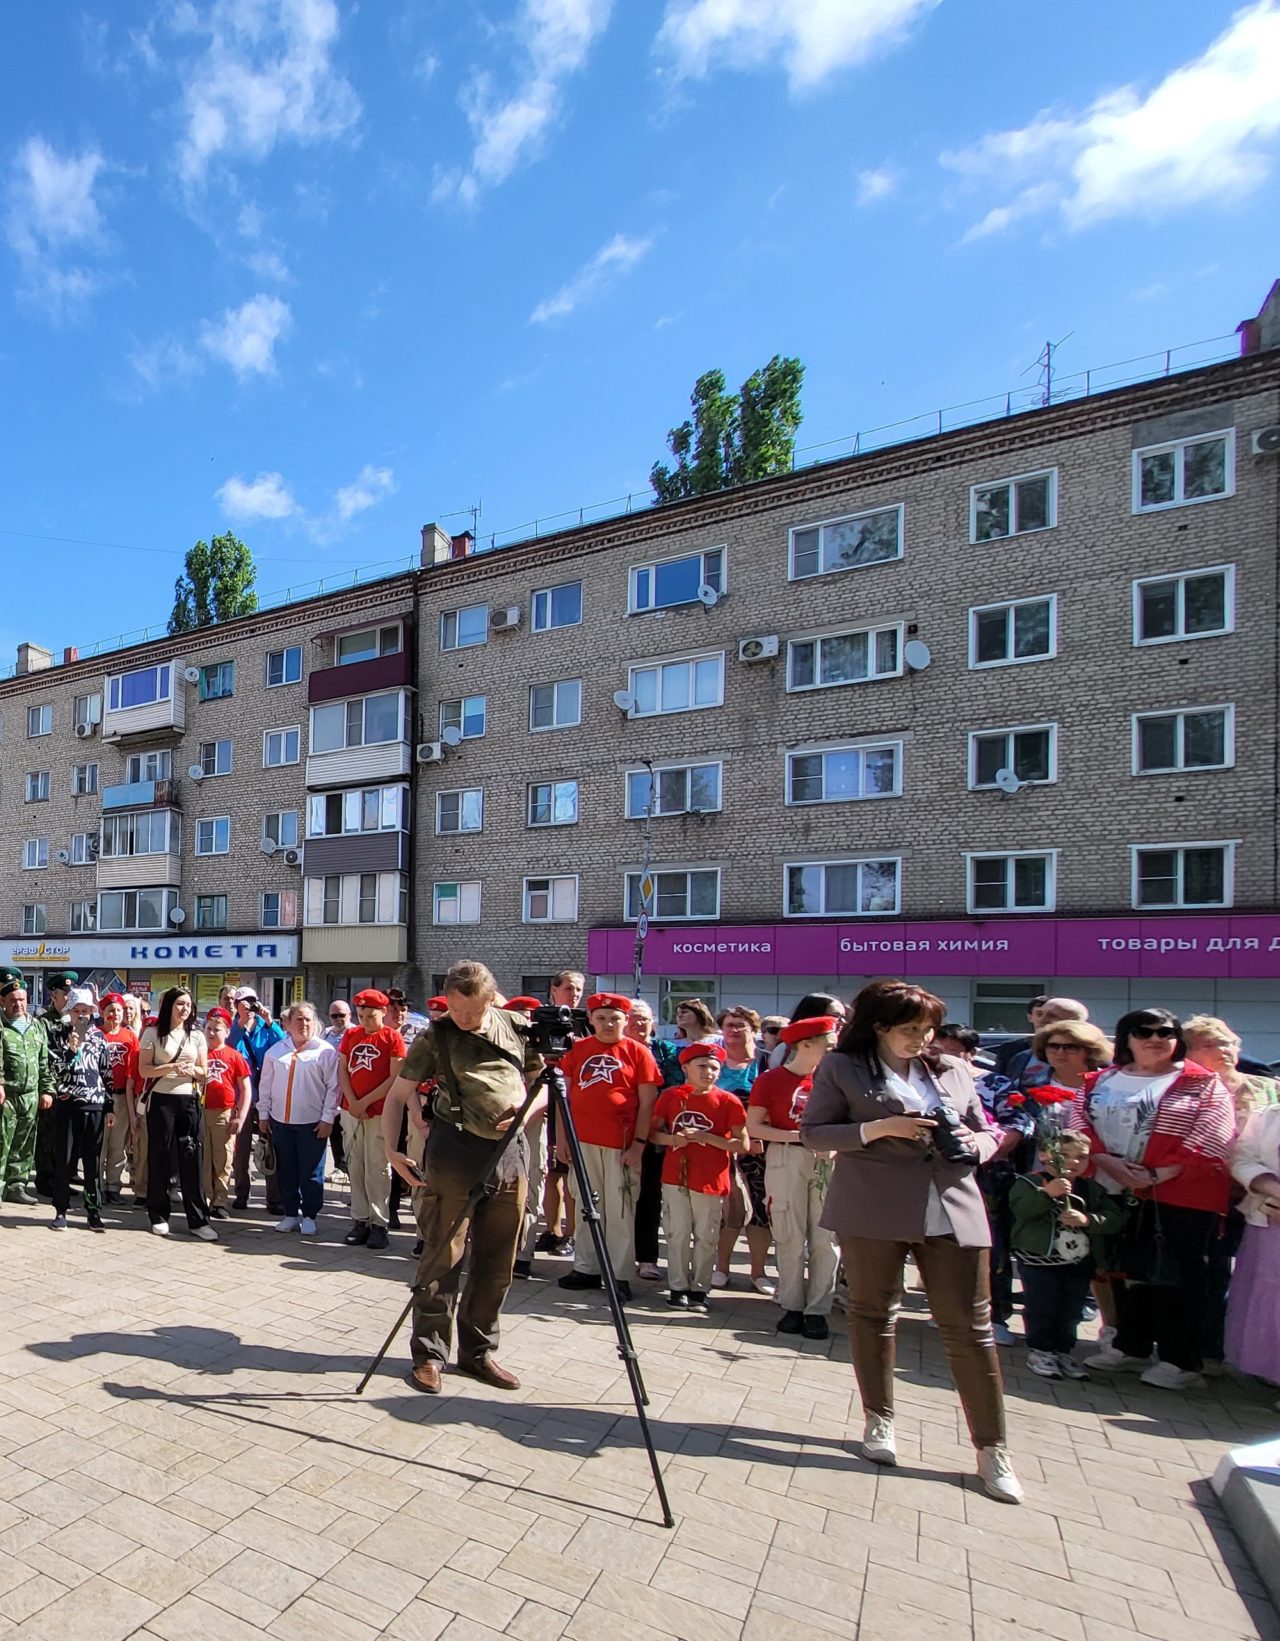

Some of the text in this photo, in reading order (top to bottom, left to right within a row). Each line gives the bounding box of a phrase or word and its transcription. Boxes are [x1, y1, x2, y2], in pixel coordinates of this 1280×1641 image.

[131, 944, 277, 959] КОМЕТА
[673, 941, 771, 953] косметика
[840, 938, 1009, 952] бытовая химия
[1098, 937, 1198, 953] товары
[1206, 937, 1259, 952] для
